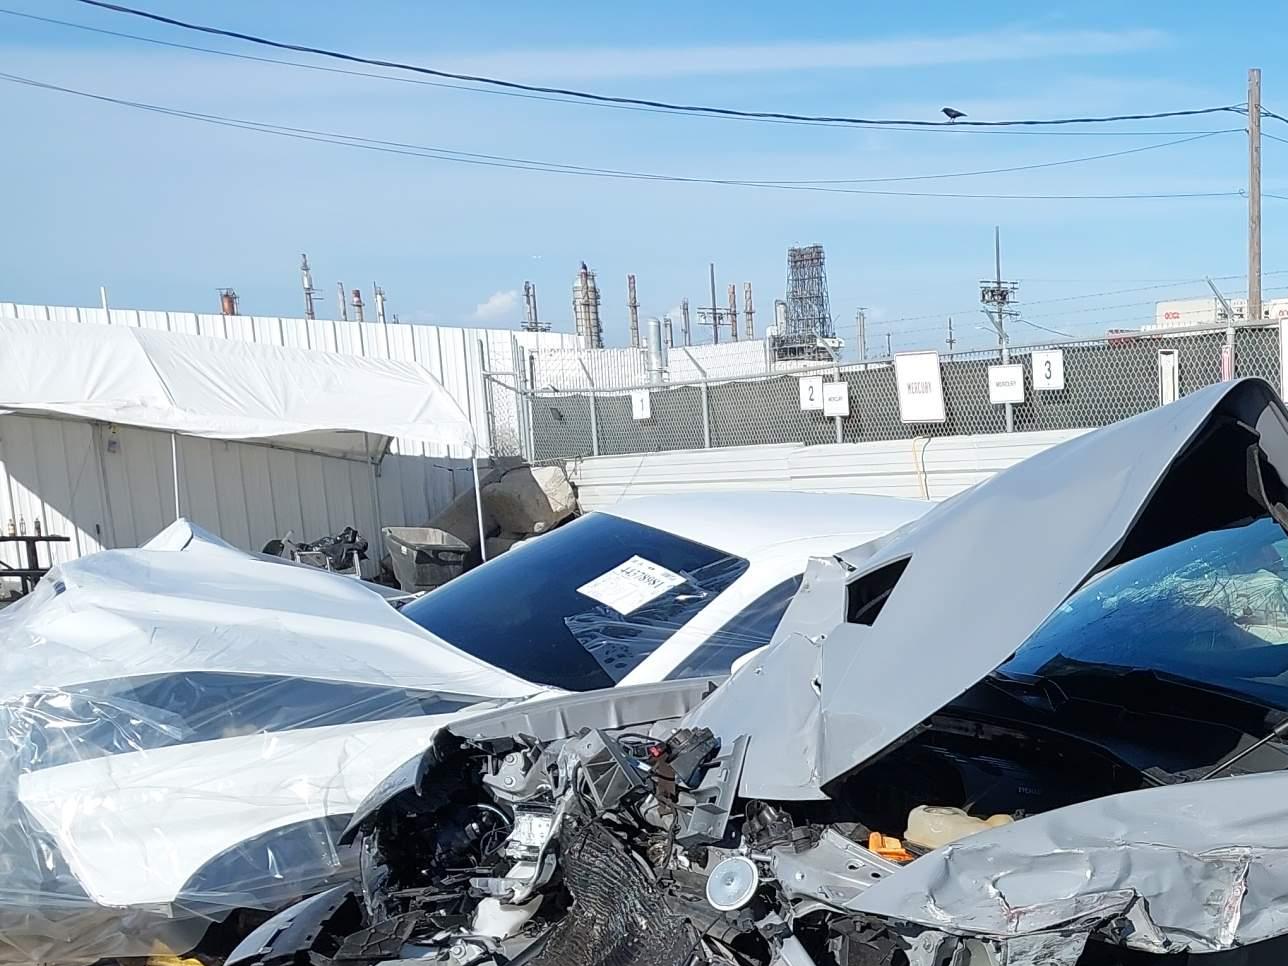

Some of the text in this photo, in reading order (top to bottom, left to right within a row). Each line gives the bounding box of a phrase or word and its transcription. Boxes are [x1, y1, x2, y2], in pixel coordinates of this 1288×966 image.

[1044, 360, 1052, 380] 3
[808, 385, 815, 401] 2
[907, 381, 932, 394] MERCURY
